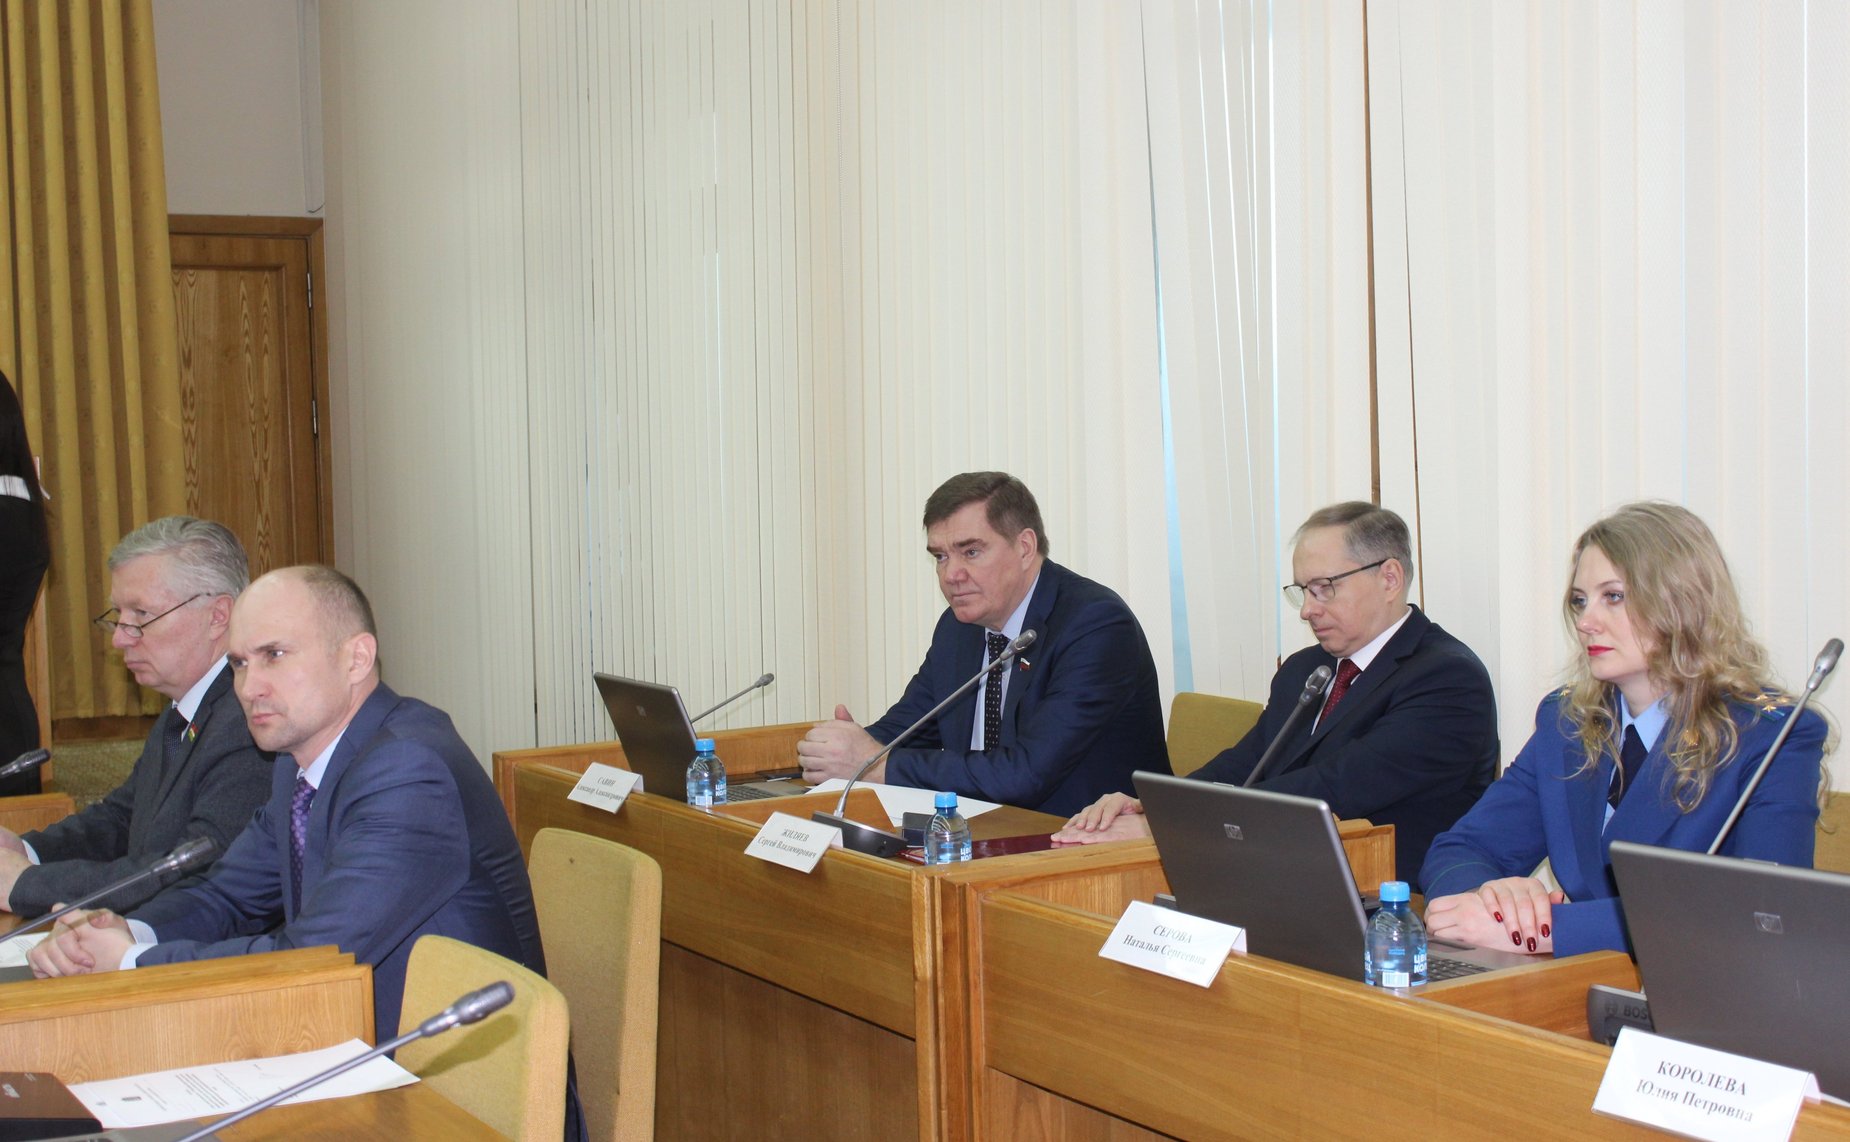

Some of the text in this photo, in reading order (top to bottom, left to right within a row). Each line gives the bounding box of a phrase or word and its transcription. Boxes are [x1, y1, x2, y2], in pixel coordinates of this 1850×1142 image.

[757, 836, 777, 847] Сергей
[1123, 934, 1160, 953] Наталья
[1153, 924, 1193, 944] СЕРОВА
[1623, 1005, 1648, 1020] BOS
[1657, 1060, 1748, 1096] КОРОЛЕВА
[1636, 1079, 1753, 1123] Юлия Петровна
